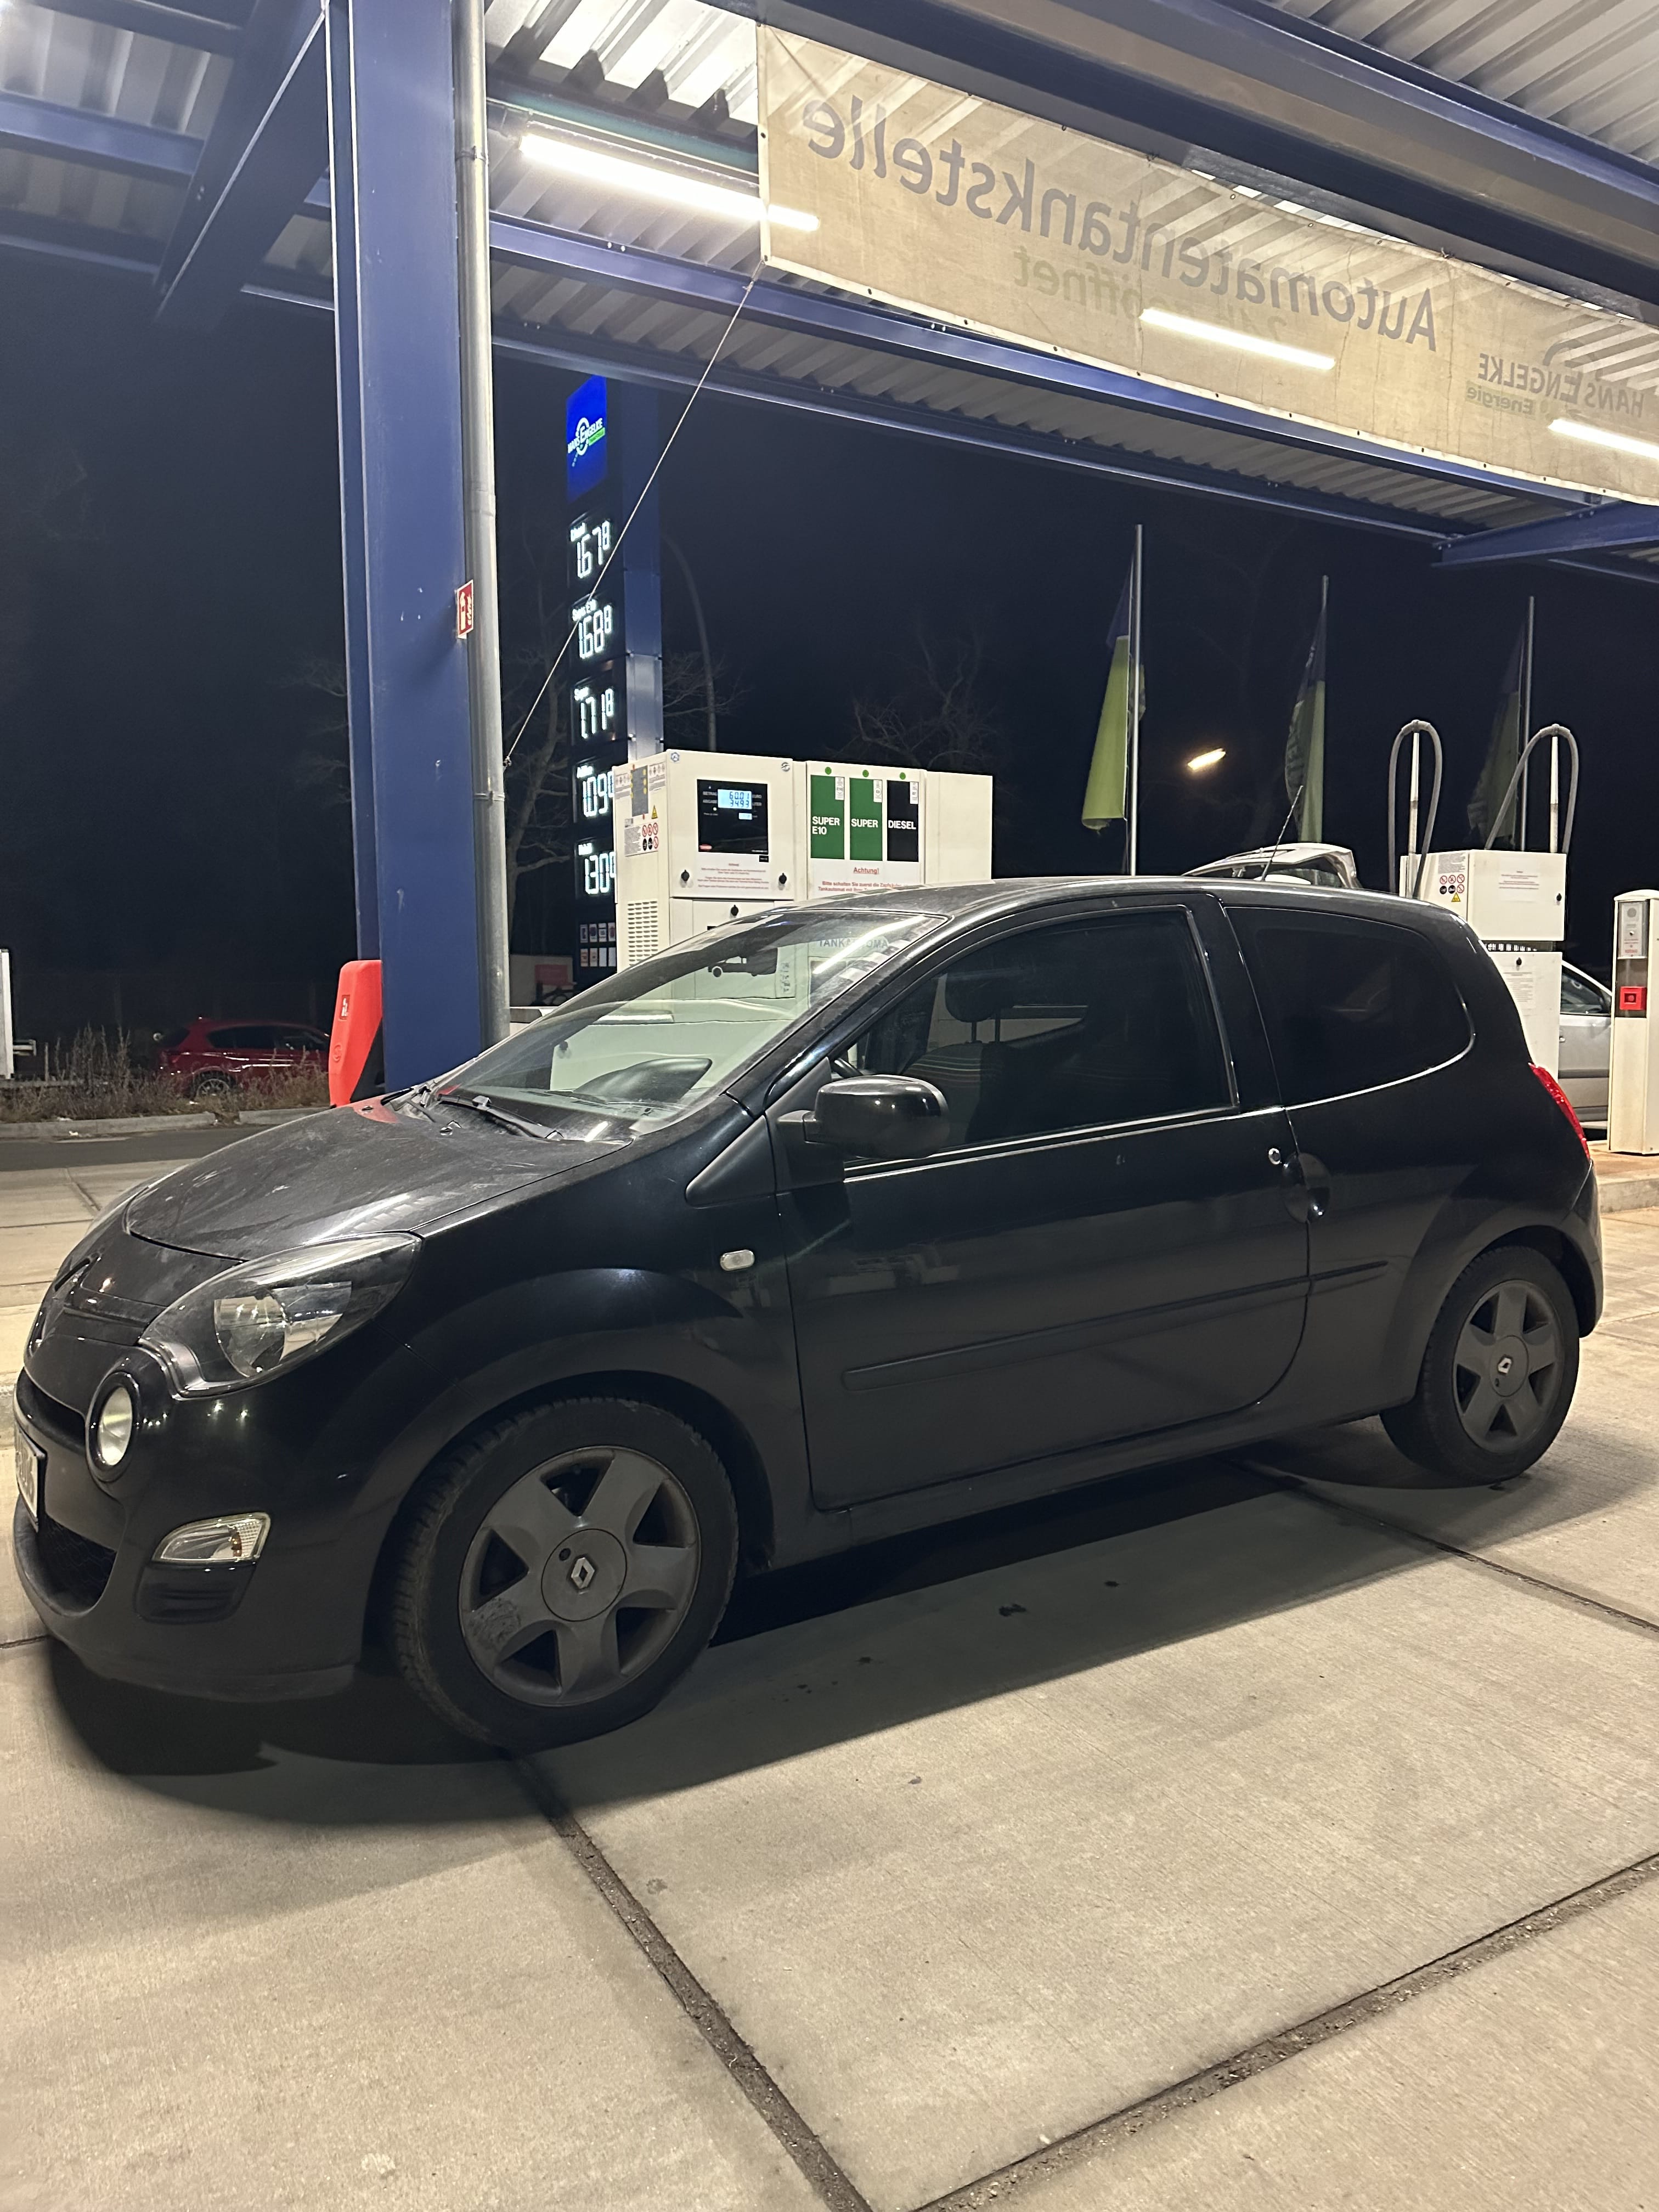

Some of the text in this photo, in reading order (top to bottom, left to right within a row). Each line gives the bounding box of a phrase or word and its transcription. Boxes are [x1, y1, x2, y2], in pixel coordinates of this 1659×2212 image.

[812, 816, 840, 826] SUPER
[851, 818, 878, 828] SUPER
[888, 820, 917, 830] DIESEL
[812, 826, 827, 835] E10
